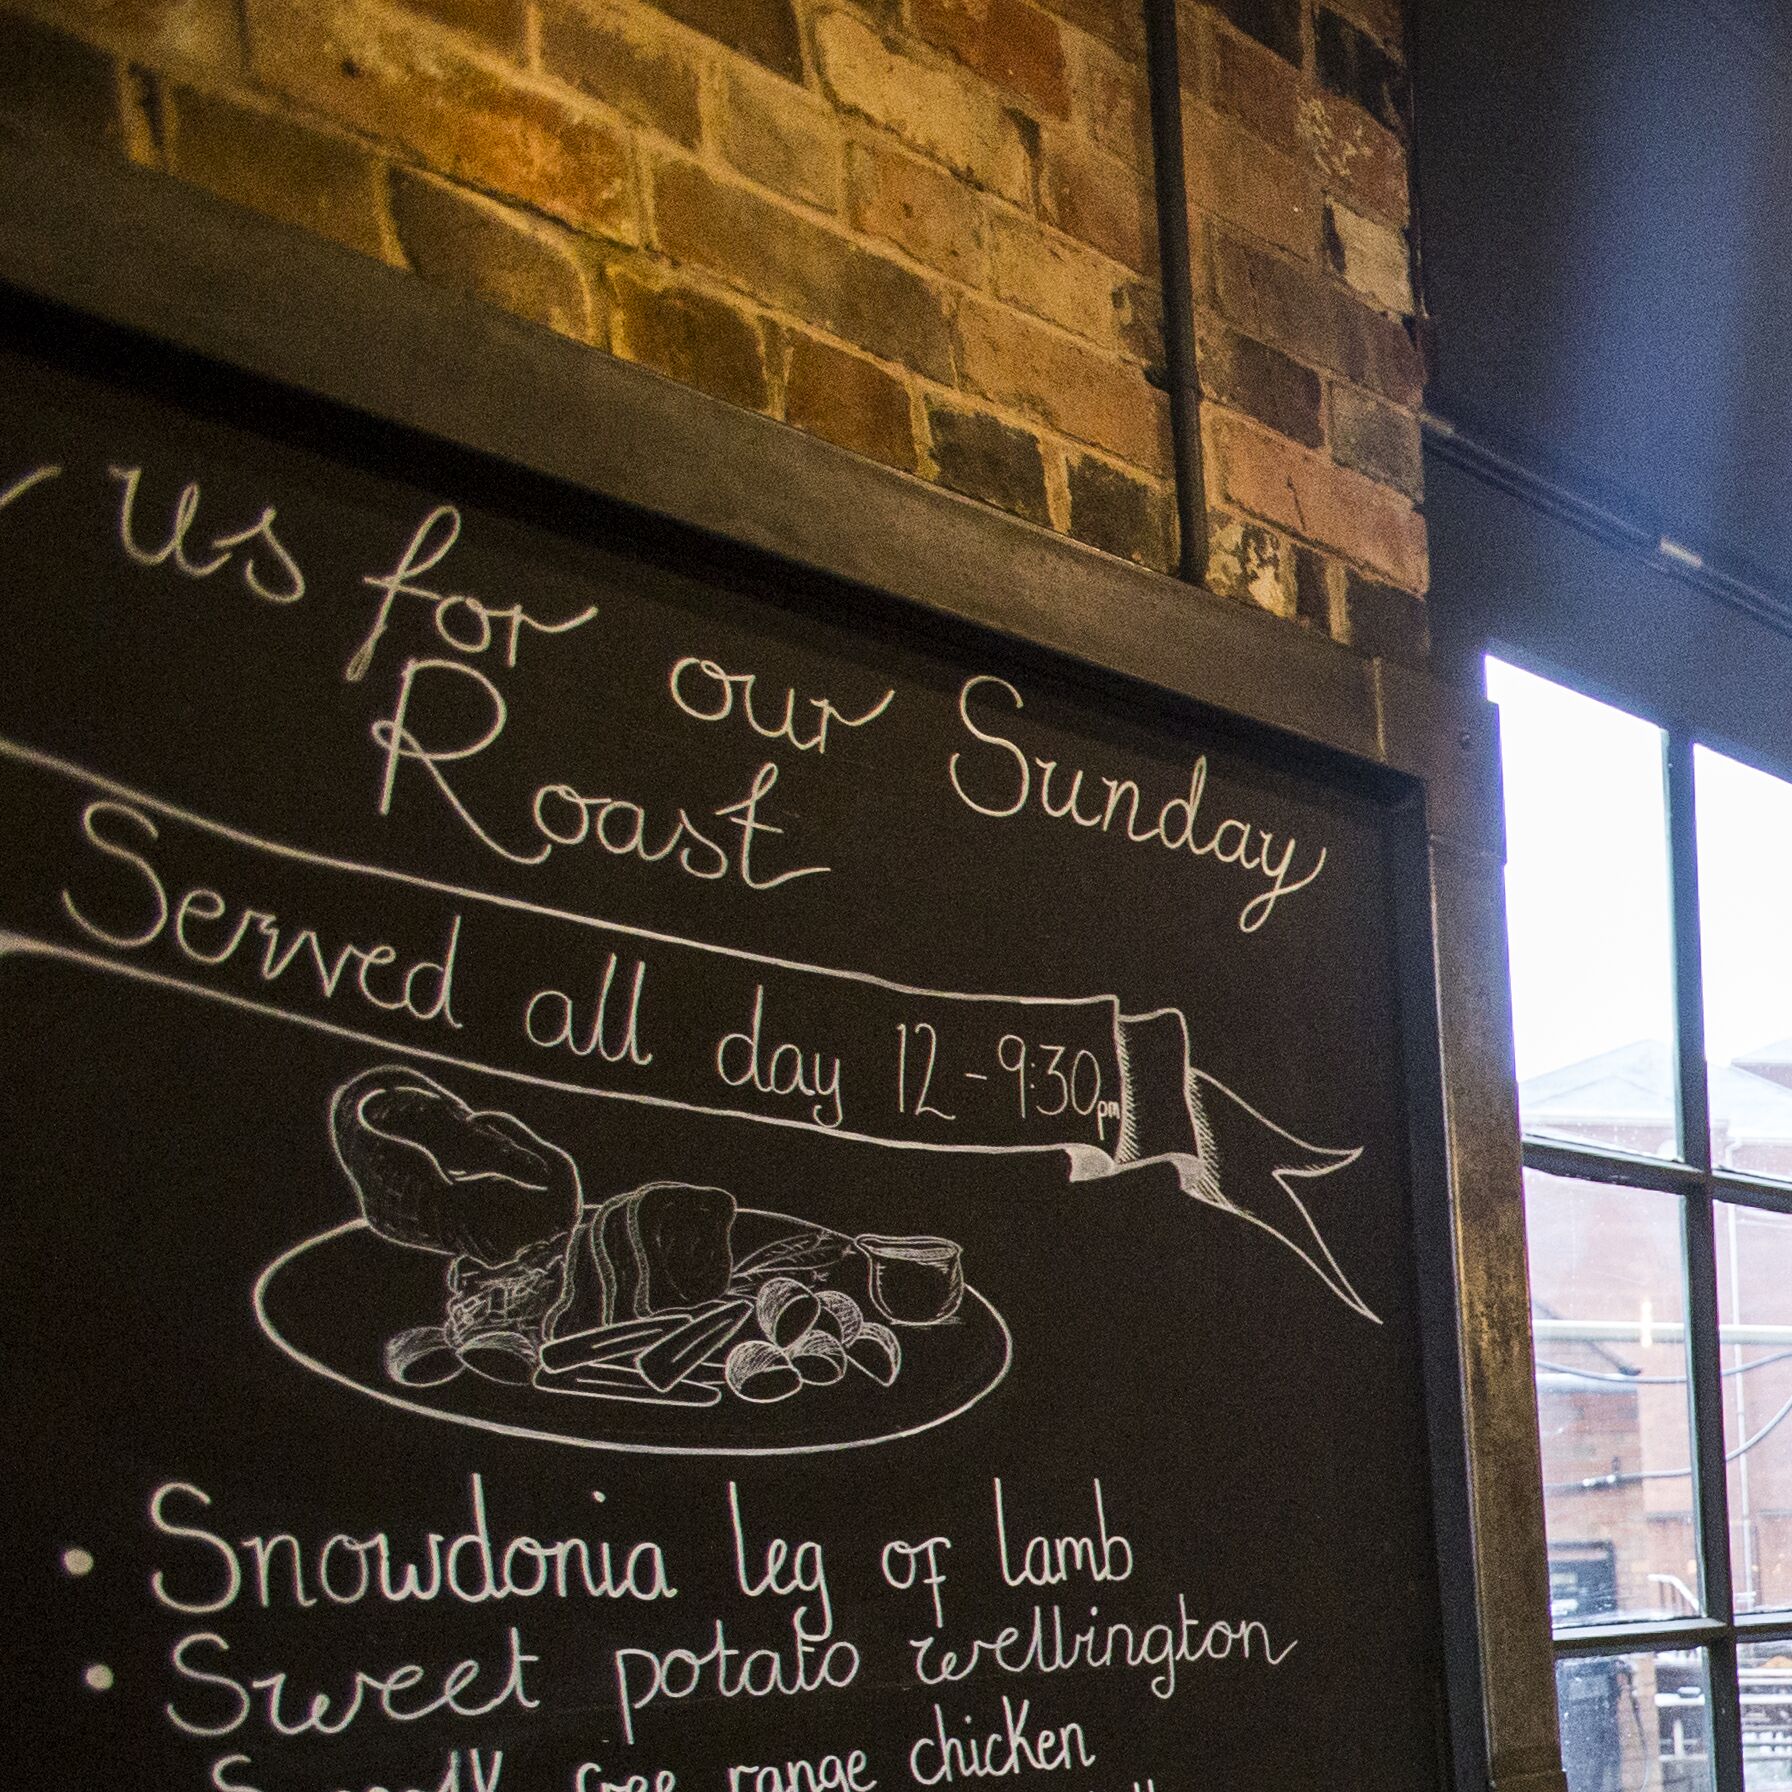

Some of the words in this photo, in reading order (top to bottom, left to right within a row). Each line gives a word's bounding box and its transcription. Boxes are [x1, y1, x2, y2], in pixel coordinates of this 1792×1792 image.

[109, 464, 305, 602] us
[346, 505, 598, 682] for
[671, 657, 895, 754] our
[949, 675, 1326, 934] Sunday
[371, 658, 831, 890] Roast
[62, 800, 463, 1029] Served
[526, 952, 653, 1066] all
[717, 984, 843, 1128] day
[150, 1472, 678, 1614] Snowdonia
[728, 1480, 833, 1642] leg
[881, 1535, 952, 1629] of
[993, 1476, 1134, 1588] lamb
[166, 1626, 541, 1737] Sweet
[615, 1619, 860, 1746] potato
[909, 1593, 1298, 1700] wellington
[909, 1695, 1096, 1786] chicken
